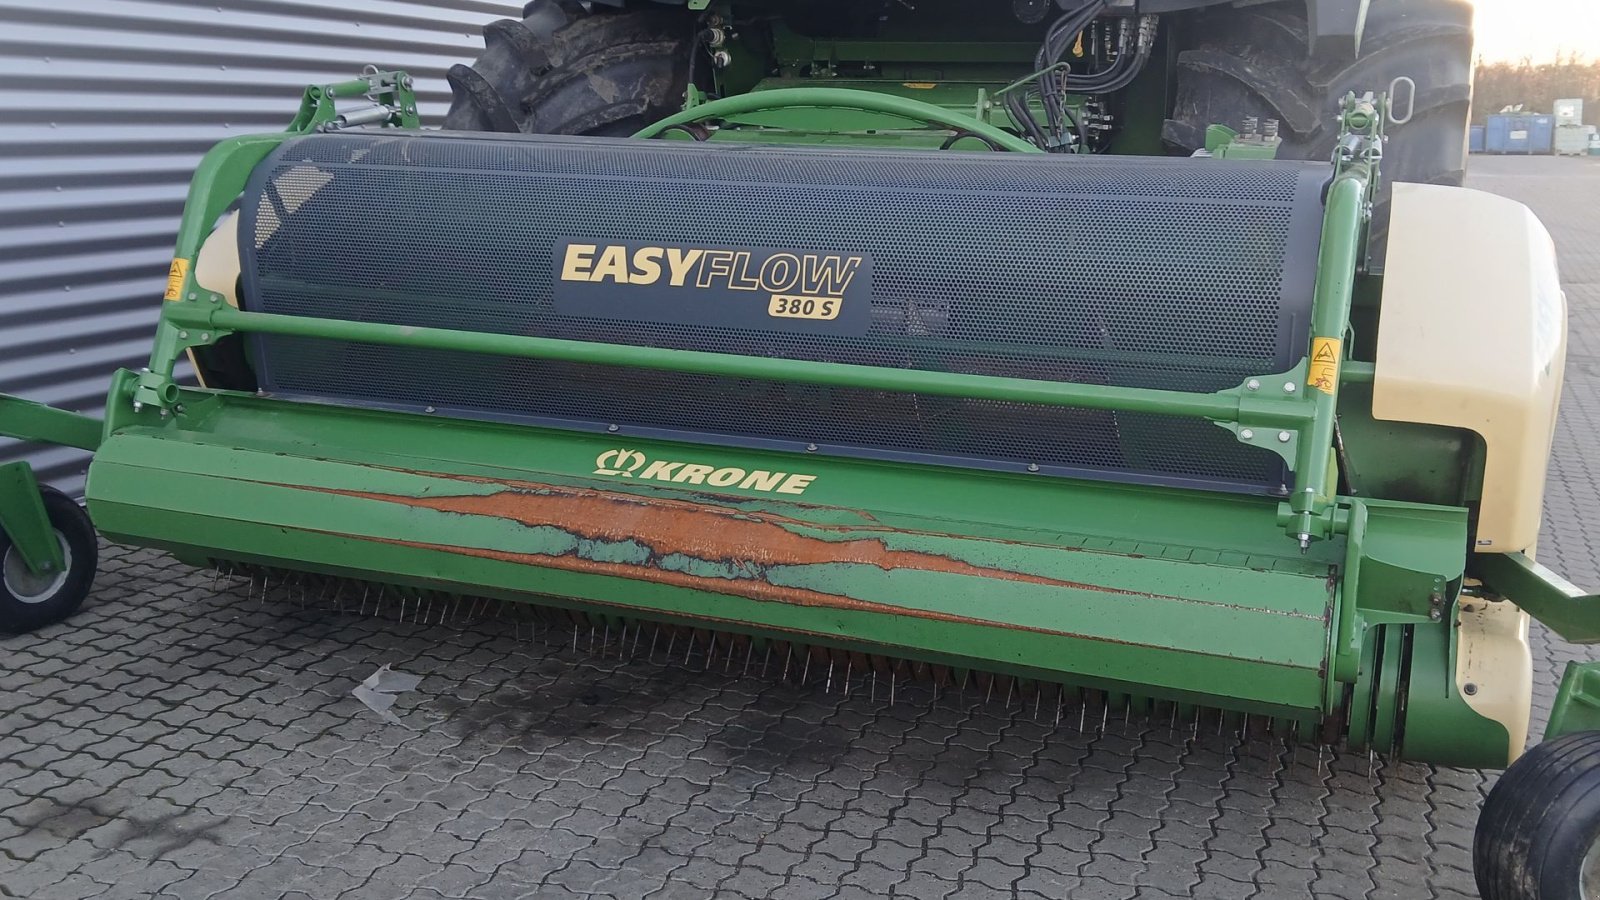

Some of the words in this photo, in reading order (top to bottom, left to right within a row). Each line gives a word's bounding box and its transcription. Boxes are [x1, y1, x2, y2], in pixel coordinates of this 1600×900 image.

[560, 243, 863, 296] EASYFLOW
[775, 298, 815, 316] 380
[820, 300, 834, 317] S
[638, 460, 818, 495] KRONE
